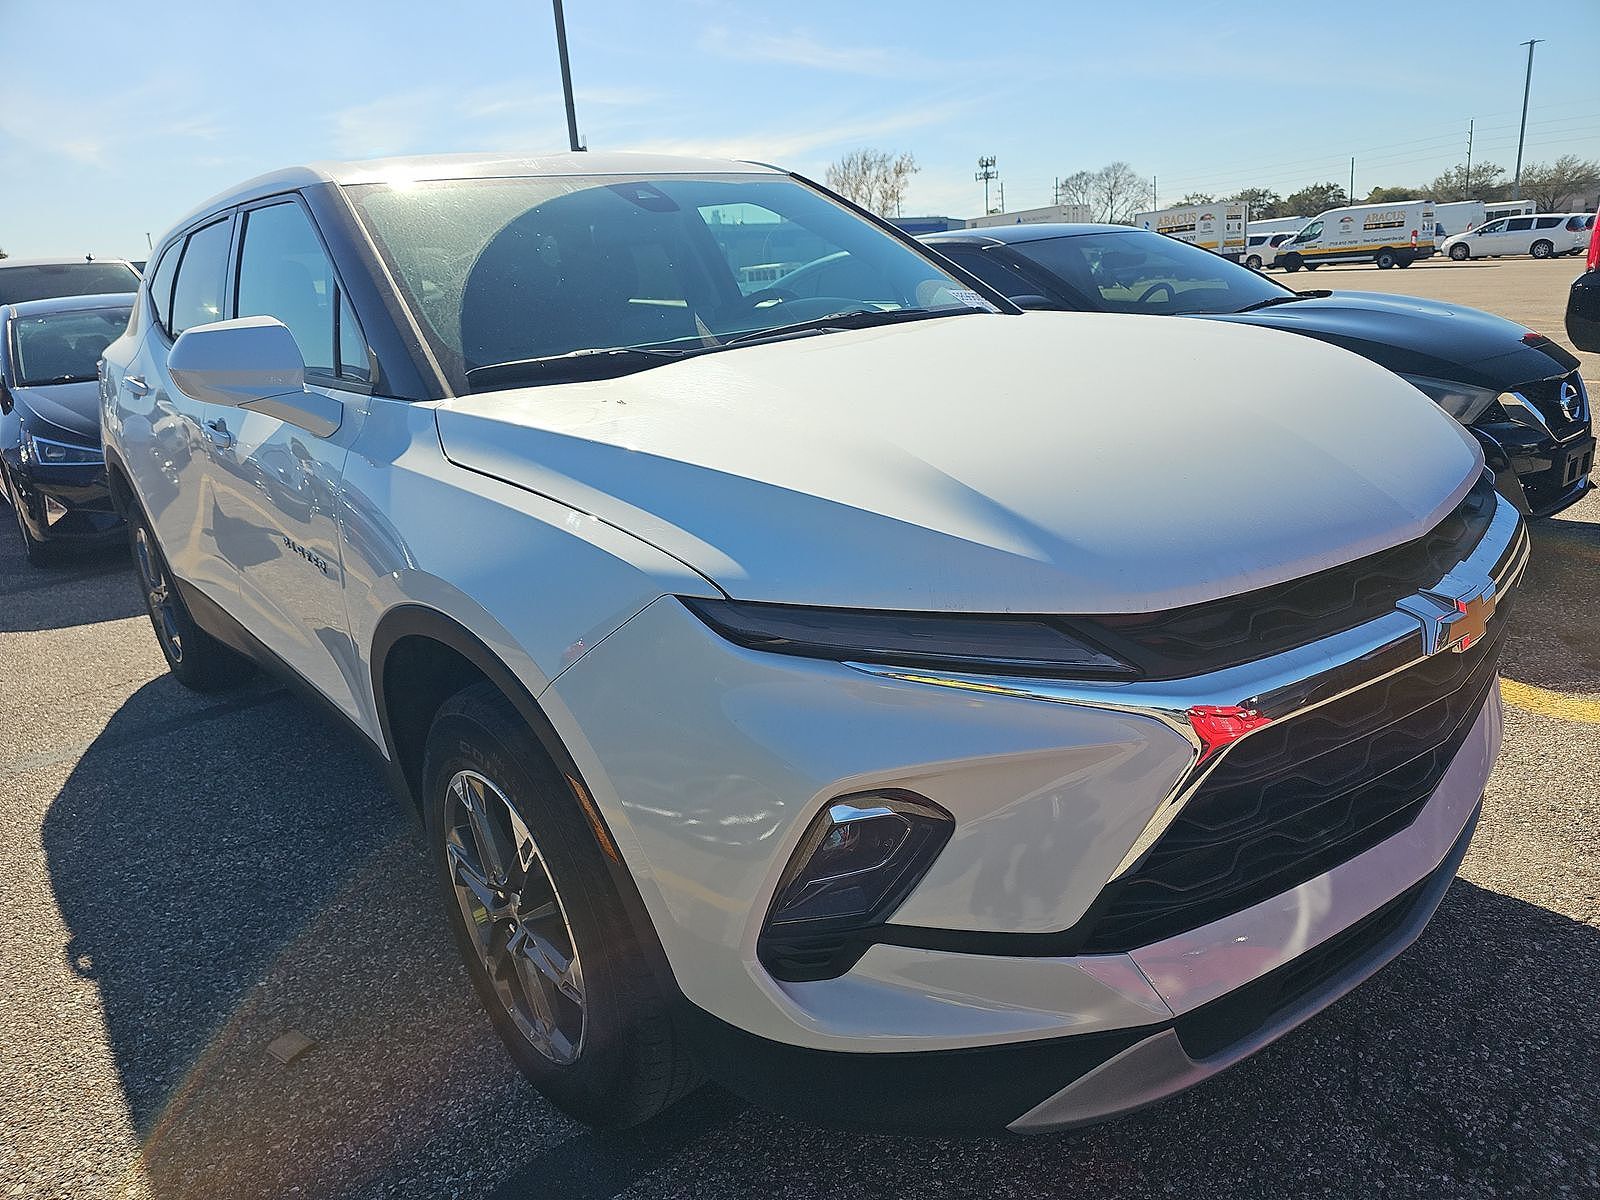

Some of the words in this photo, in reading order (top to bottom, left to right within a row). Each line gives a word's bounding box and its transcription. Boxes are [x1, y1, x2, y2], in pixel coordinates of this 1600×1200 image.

[1158, 212, 1197, 225] ABACUS
[1364, 210, 1406, 222] ABACUS
[283, 536, 328, 574] BLAZER
